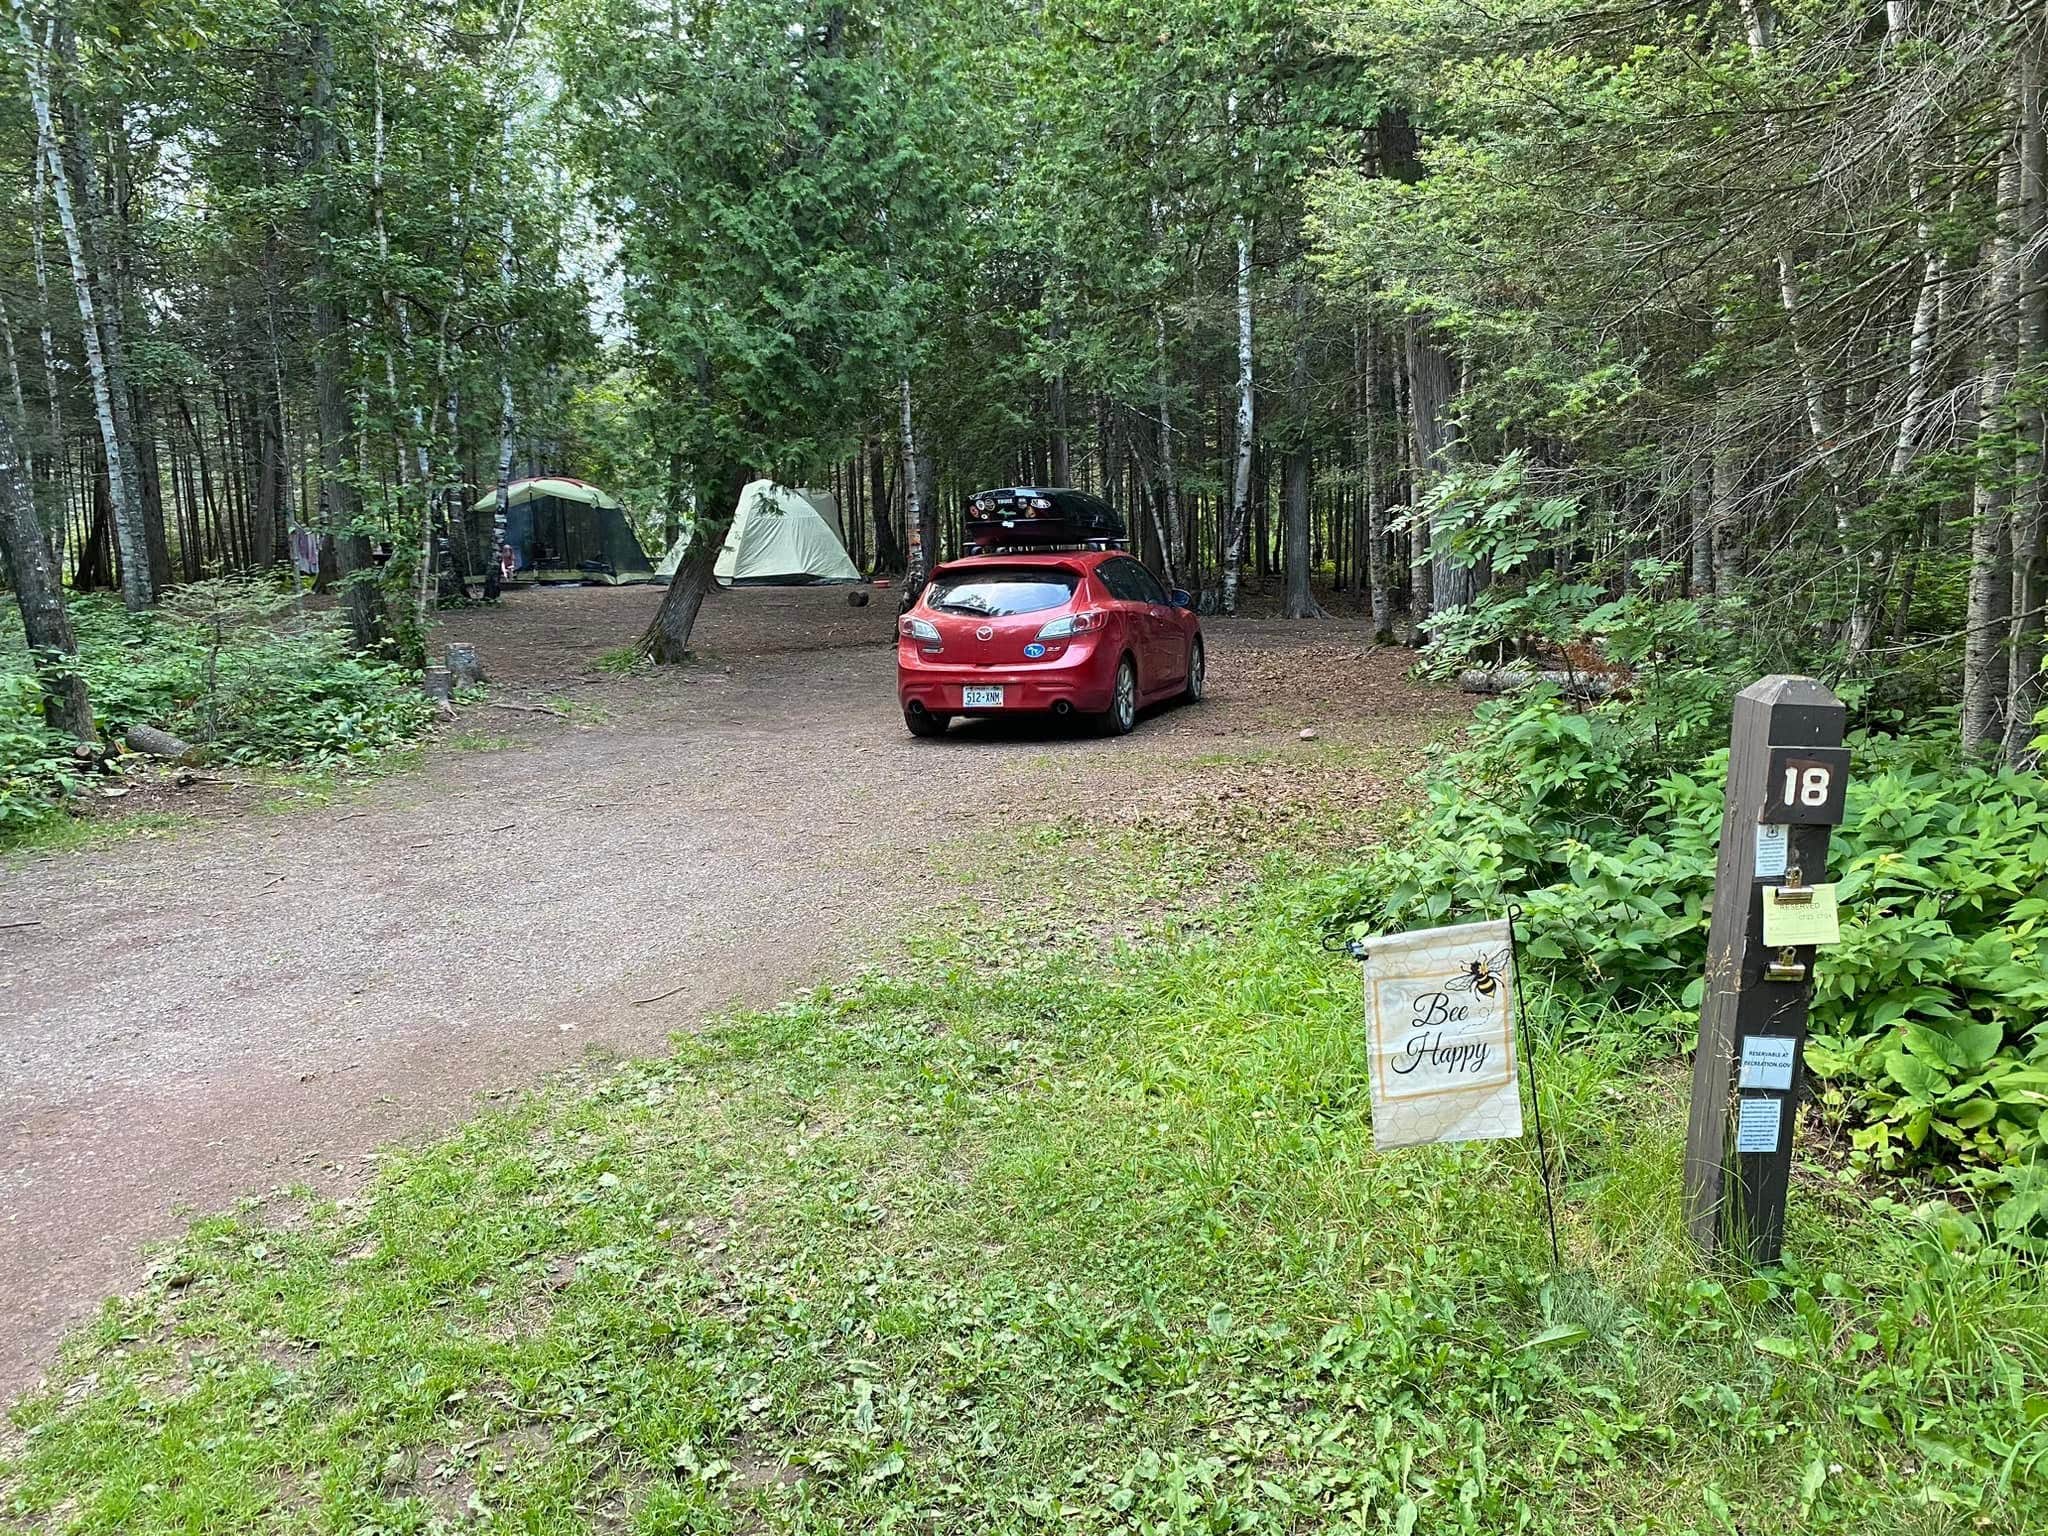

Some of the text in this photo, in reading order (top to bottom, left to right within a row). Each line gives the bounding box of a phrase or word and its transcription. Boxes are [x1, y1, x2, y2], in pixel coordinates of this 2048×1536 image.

[966, 692, 1000, 703] 512-XNM
[1784, 766, 1830, 806] 18
[1780, 902, 1820, 911] RESERVED
[1412, 992, 1469, 1028] Bee
[1391, 1031, 1490, 1074] Happy
[1744, 1060, 1792, 1069] RECREATION.GOV
